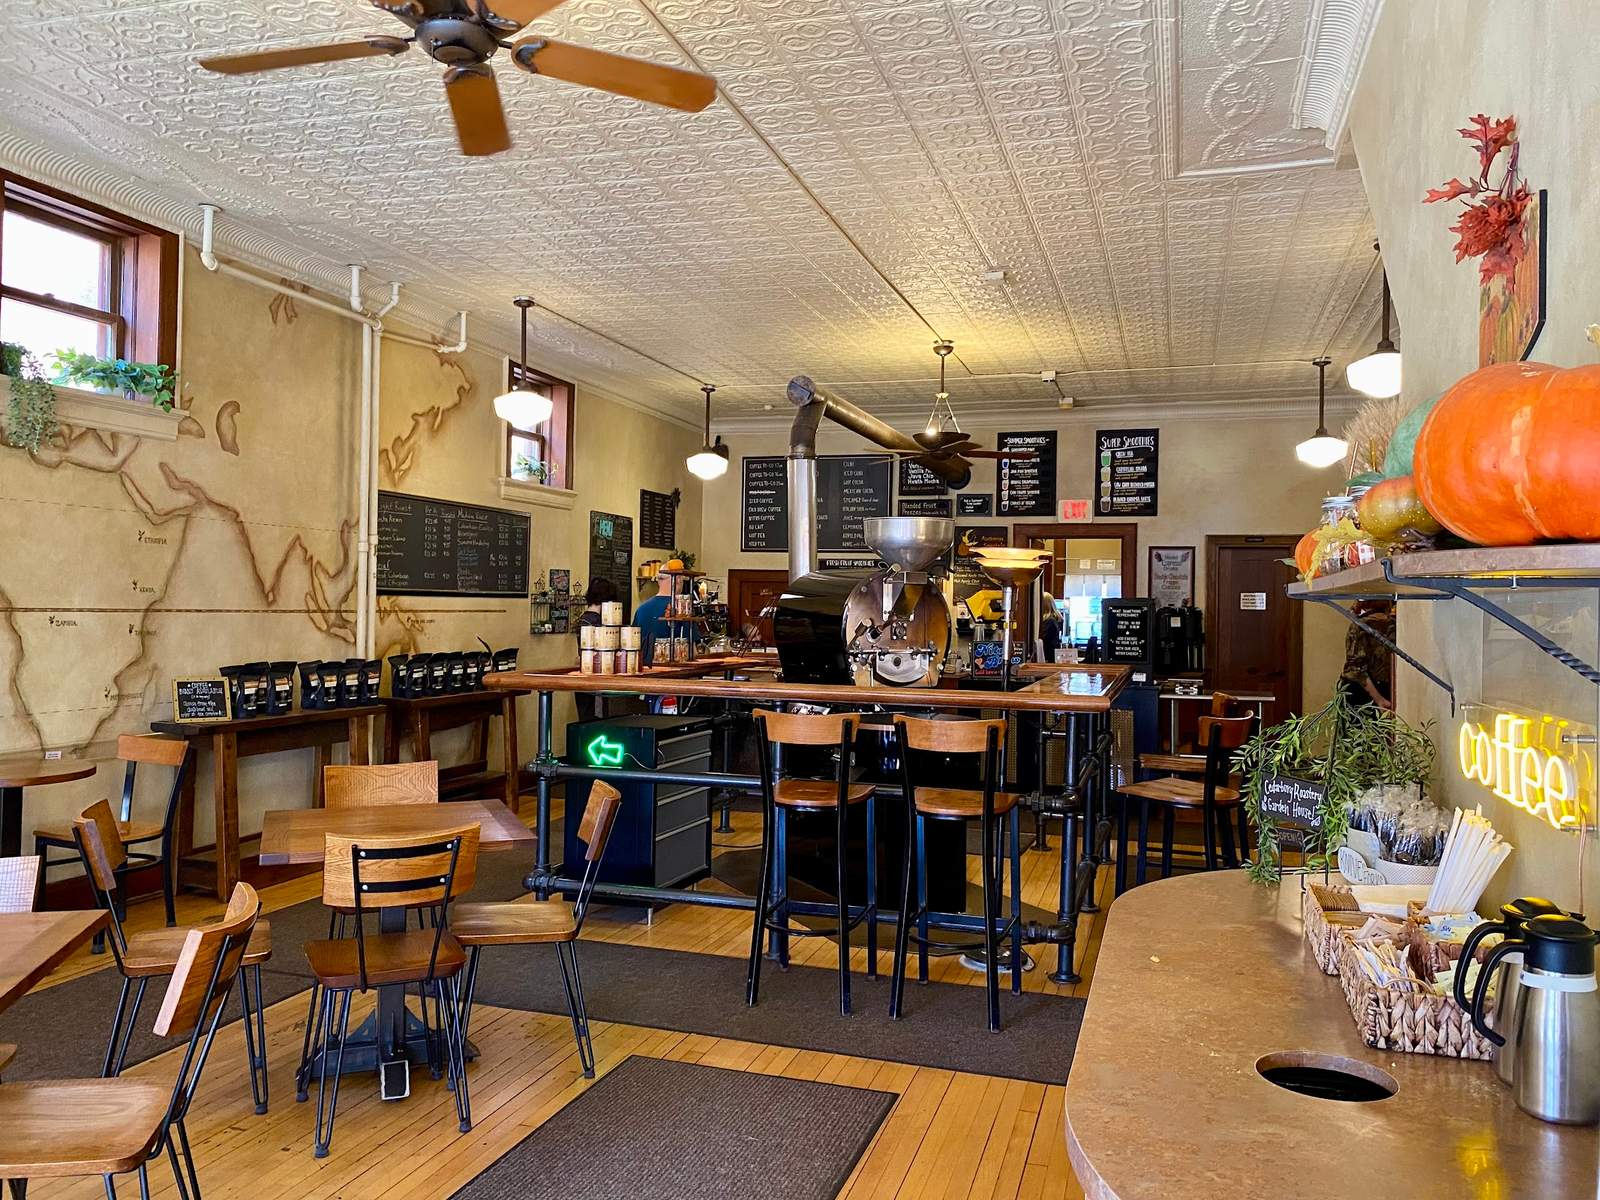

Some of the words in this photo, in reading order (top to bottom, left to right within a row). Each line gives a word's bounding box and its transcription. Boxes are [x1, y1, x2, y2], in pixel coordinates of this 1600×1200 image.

[1023, 436, 1046, 444] SMOOTHIES
[1101, 436, 1121, 448] SUPER
[1123, 436, 1154, 448] SMOOTHIES
[1460, 714, 1576, 829] coffee
[1294, 783, 1322, 809] Roastery
[1268, 798, 1290, 816] Garden
